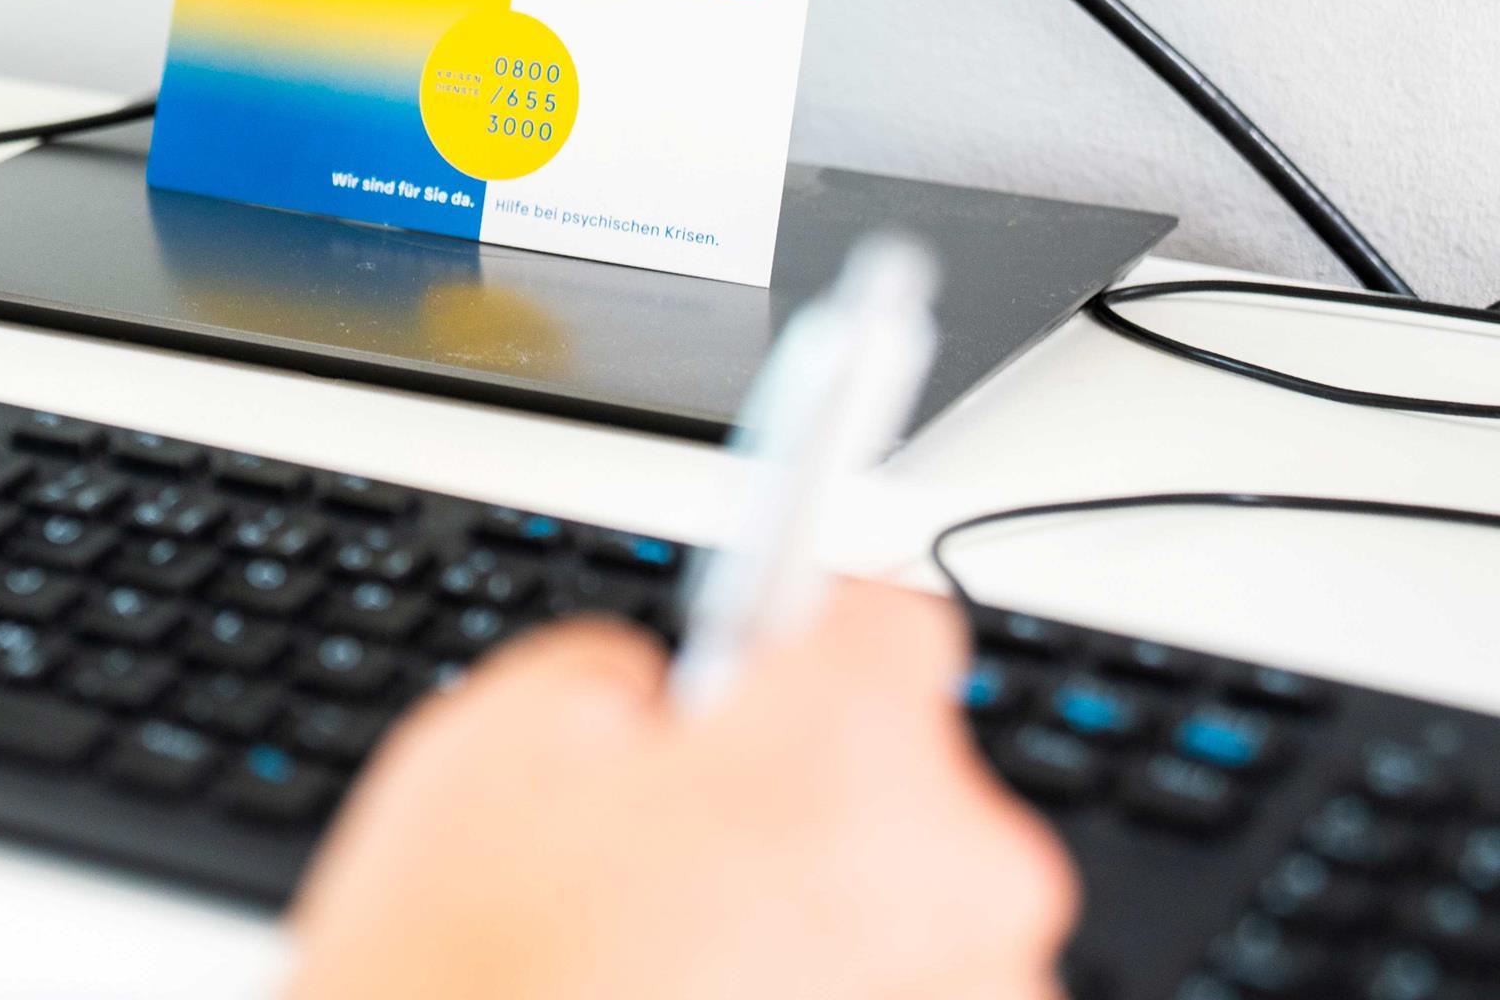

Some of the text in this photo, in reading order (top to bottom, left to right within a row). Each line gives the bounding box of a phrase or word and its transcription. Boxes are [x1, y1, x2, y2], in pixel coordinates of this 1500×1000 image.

[495, 56, 560, 83] 0800
[490, 85, 556, 113] /655
[487, 114, 552, 141] 3000
[332, 171, 476, 208] Wir sind für Sie da.
[495, 198, 720, 247] Hilfe bei psychischen Krisen.
